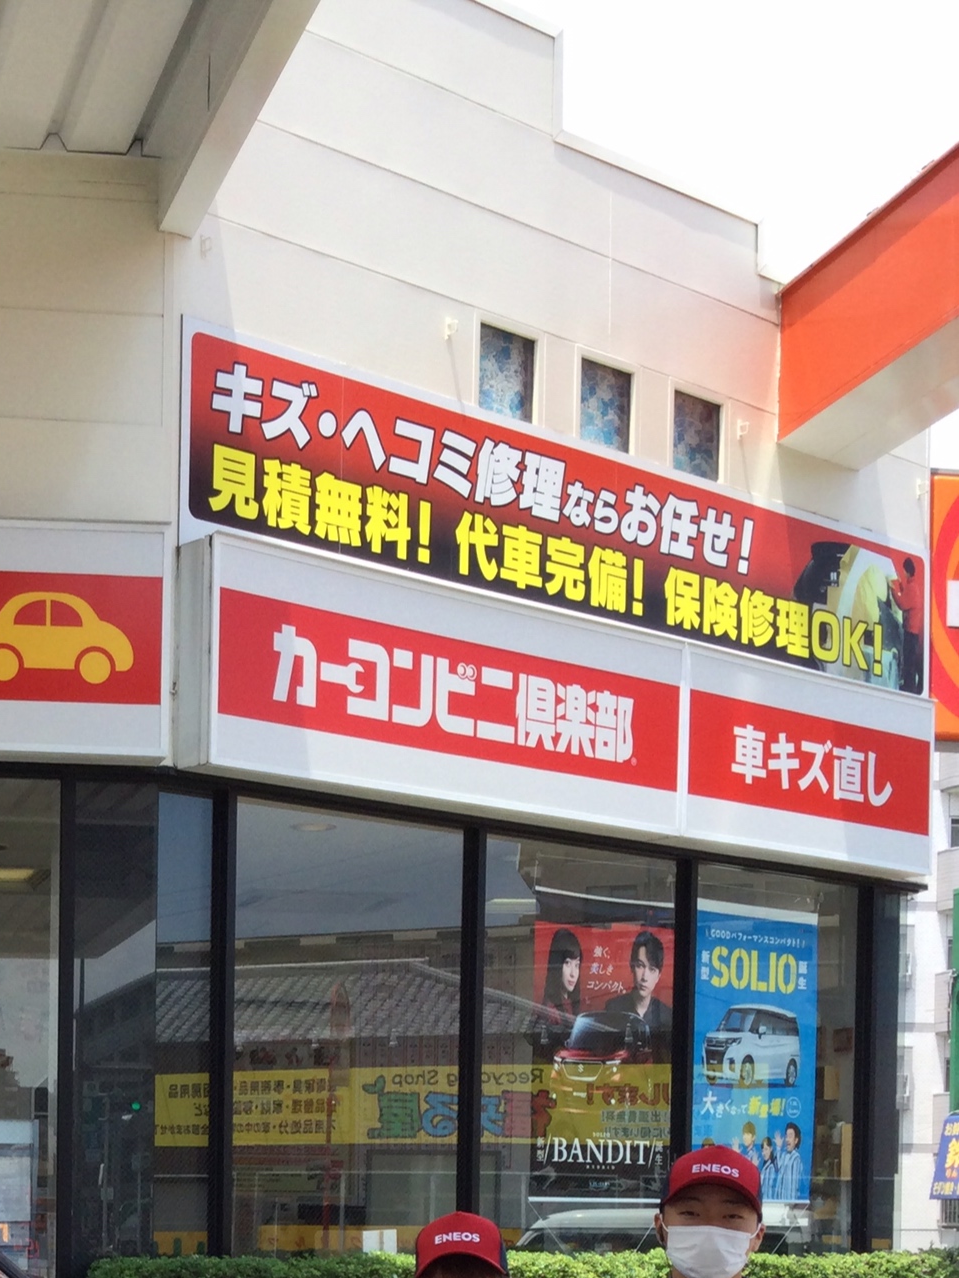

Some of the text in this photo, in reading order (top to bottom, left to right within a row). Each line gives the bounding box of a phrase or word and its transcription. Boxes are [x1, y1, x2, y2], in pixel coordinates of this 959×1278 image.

[210, 362, 755, 577] キズ・ヘコミ修理ならお任せ!
[208, 443, 884, 678] 見積無料! 代車完備! 保険修理OK!
[273, 624, 636, 764] カーコンビニ倶楽部
[731, 723, 893, 807] 車キズ直し
[710, 945, 797, 995] SOLIO
[691, 1163, 740, 1178] ENEOS
[434, 1231, 481, 1245] ENEOS
